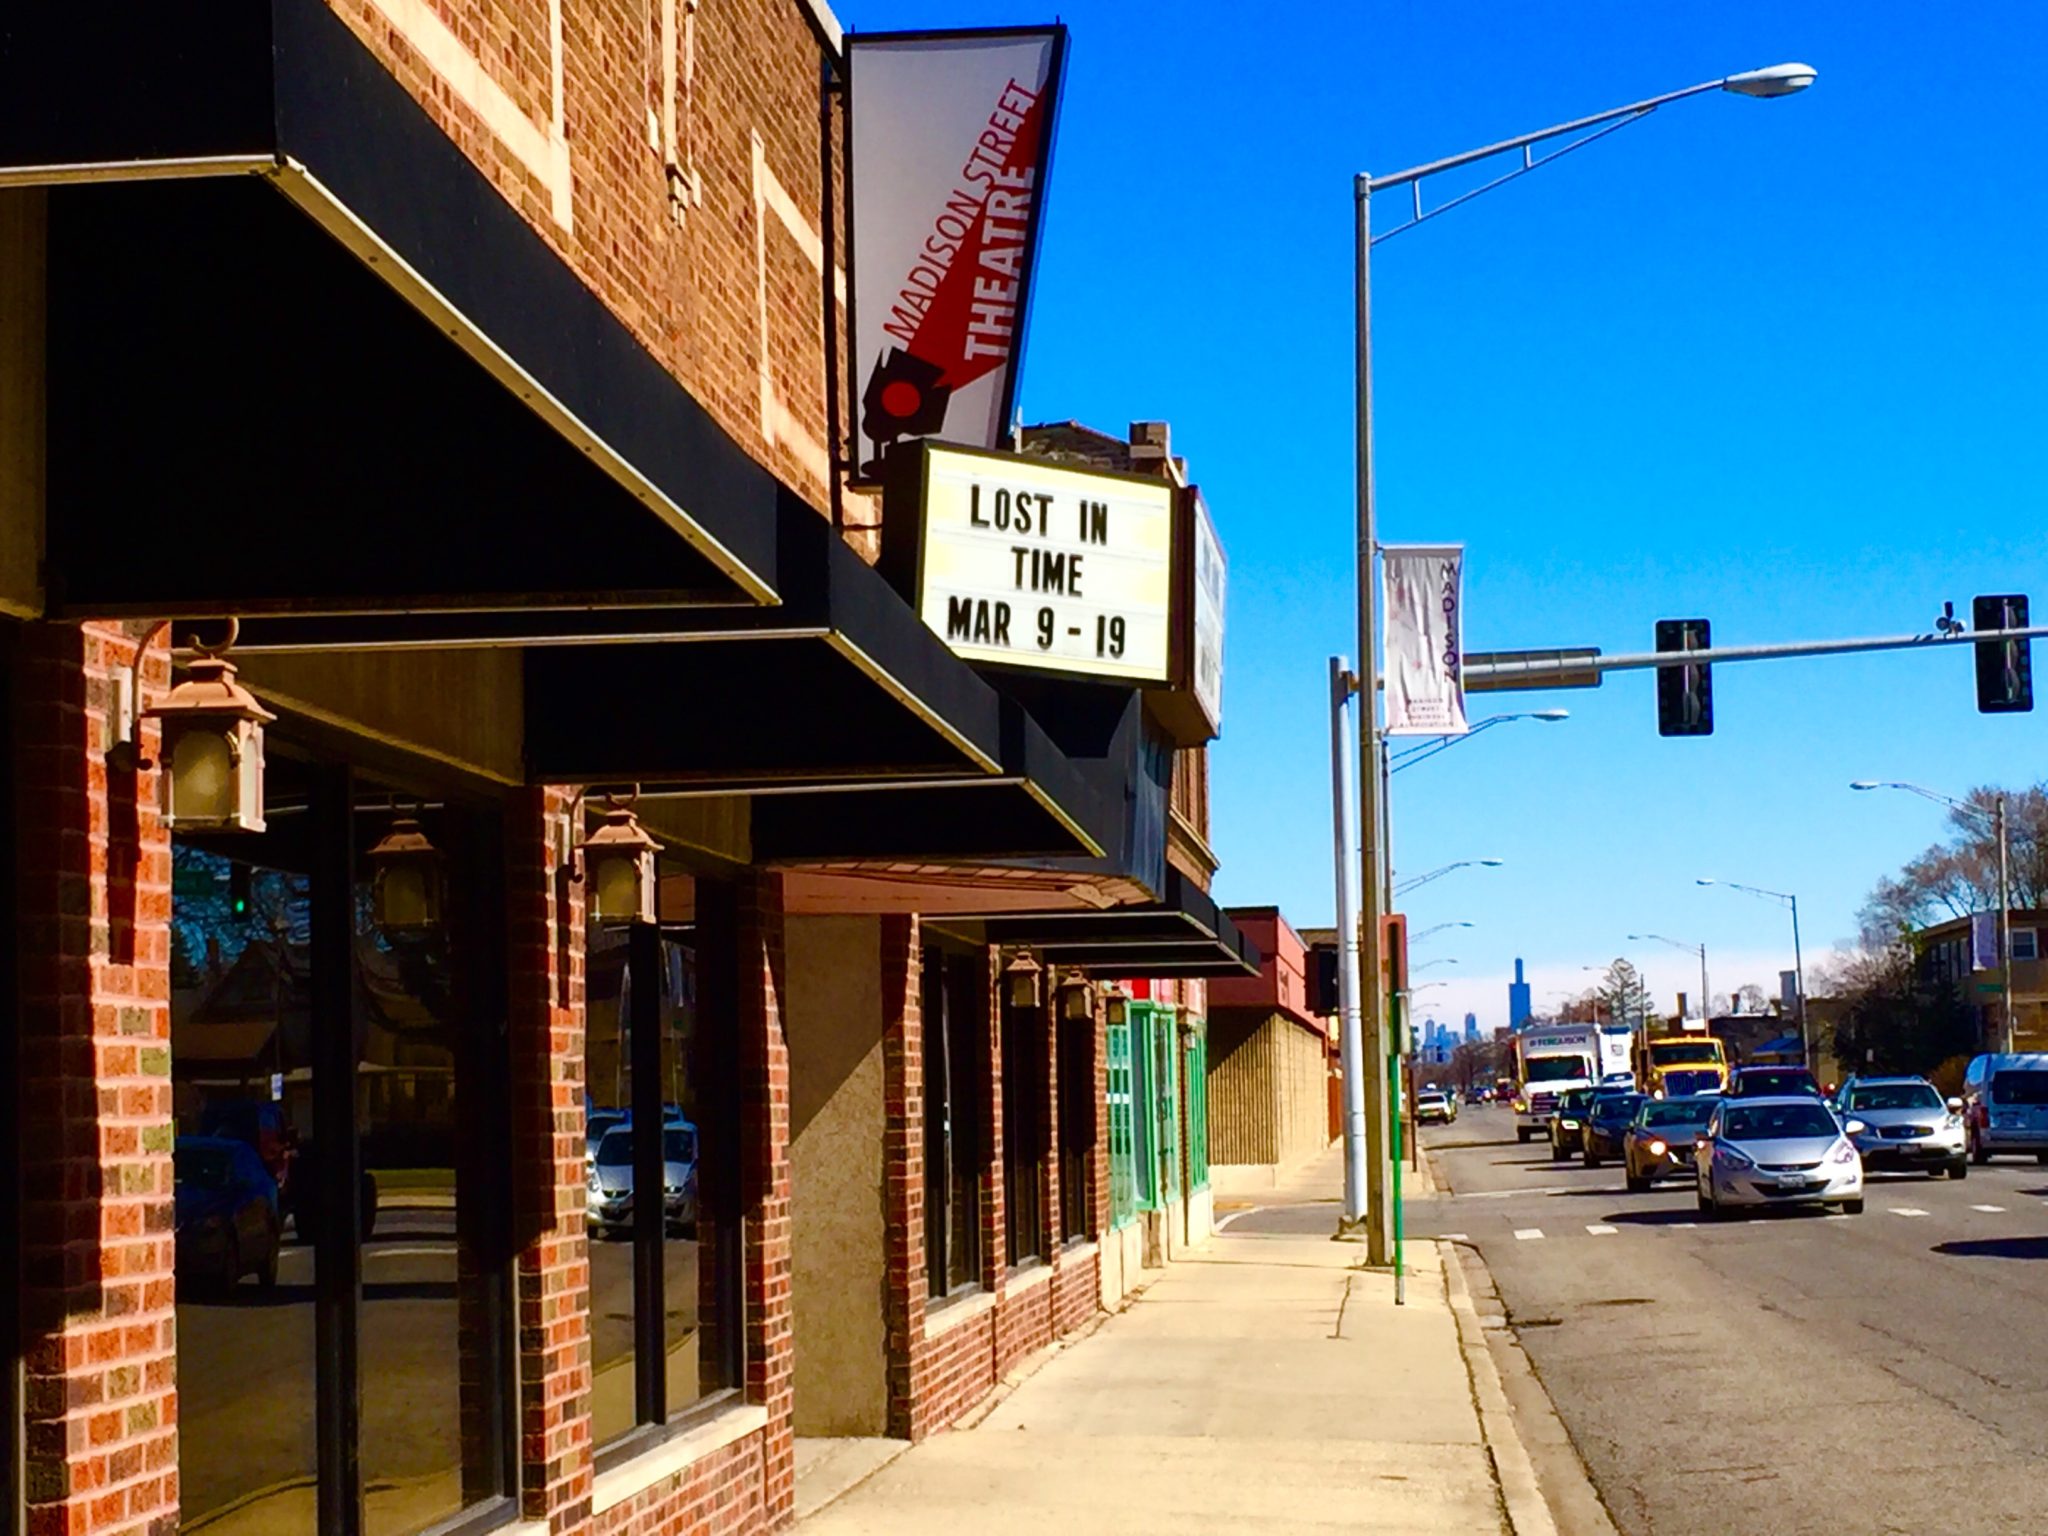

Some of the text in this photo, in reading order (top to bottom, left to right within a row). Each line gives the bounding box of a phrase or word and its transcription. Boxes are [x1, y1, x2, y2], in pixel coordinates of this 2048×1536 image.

[883, 77, 1037, 351] MADISON STREET
[964, 165, 1036, 361] THEATRE
[971, 484, 1108, 546] LOST IN
[1011, 546, 1084, 598] TIME
[947, 595, 1011, 647] MAR
[1441, 562, 1459, 684] MADISON
